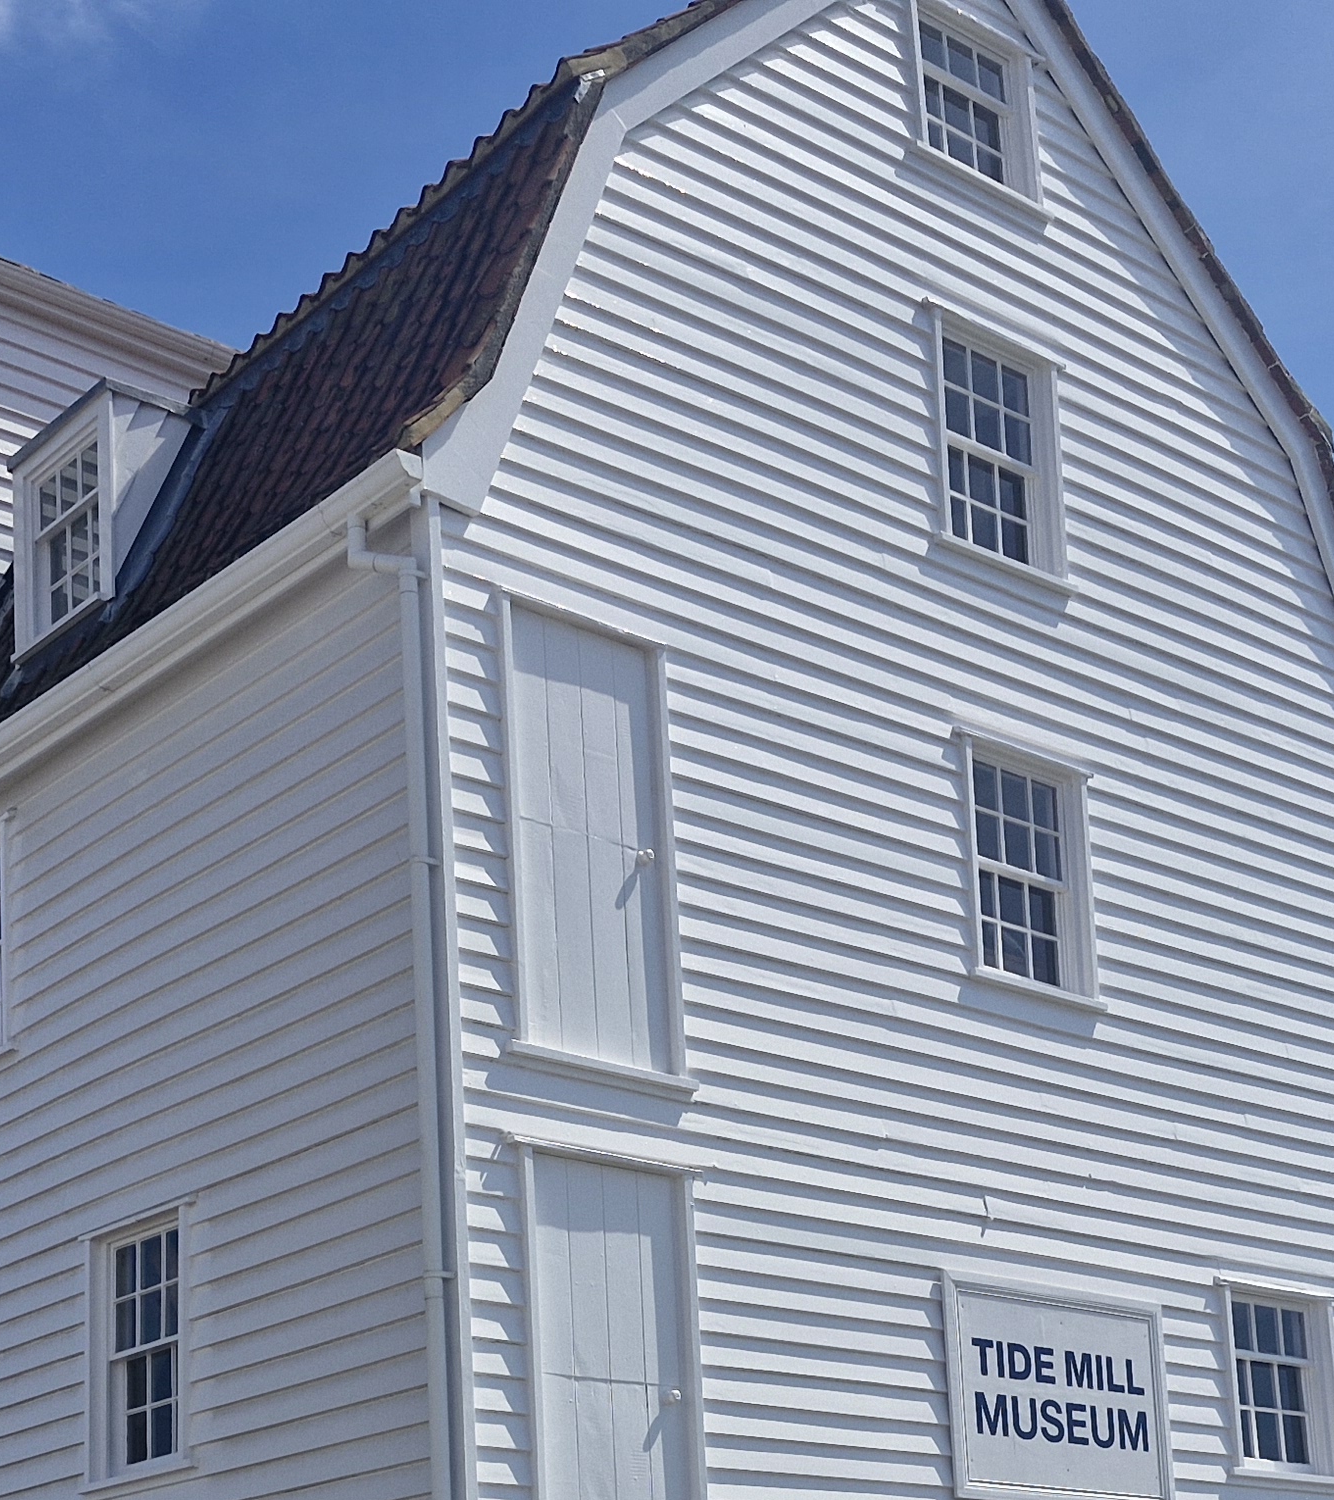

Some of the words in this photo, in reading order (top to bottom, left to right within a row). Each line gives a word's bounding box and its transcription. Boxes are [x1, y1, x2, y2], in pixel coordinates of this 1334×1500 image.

[971, 1337, 1056, 1384] TIDE
[1065, 1350, 1145, 1396] MILL
[975, 1391, 1149, 1452] MUSEUM
